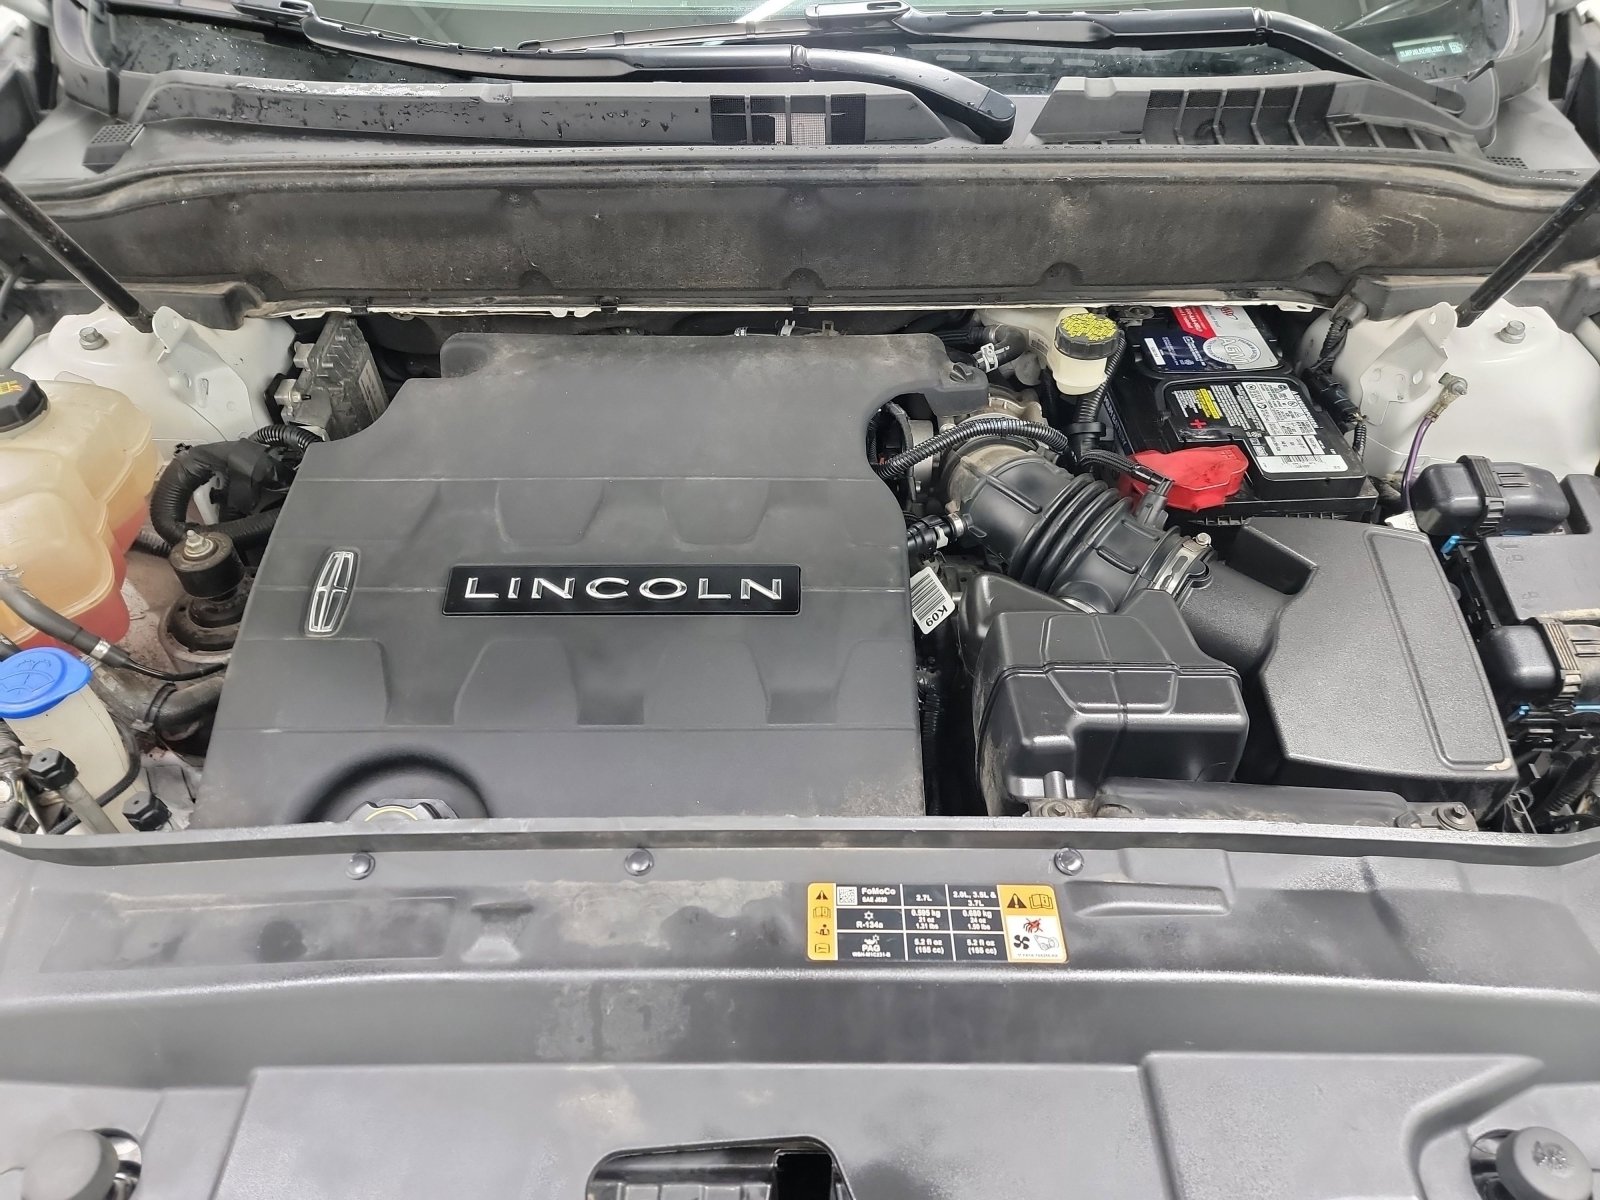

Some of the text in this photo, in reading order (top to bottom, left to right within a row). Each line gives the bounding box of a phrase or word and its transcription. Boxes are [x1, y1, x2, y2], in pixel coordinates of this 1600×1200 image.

[1220, 338, 1249, 365] AGM
[464, 577, 782, 600] LINCOLN
[925, 604, 948, 627] K09
[861, 887, 896, 895] FoMoCo
[953, 890, 971, 899] 2.0L,
[915, 894, 933, 902] 2.7L
[967, 899, 985, 907] 3.7L
[931, 909, 941, 918] kg
[982, 910, 992, 919] kg
[856, 921, 884, 929] R-134a
[861, 944, 881, 952] PAG
[932, 946, 945, 954] cc)
[985, 947, 997, 956] cc)
